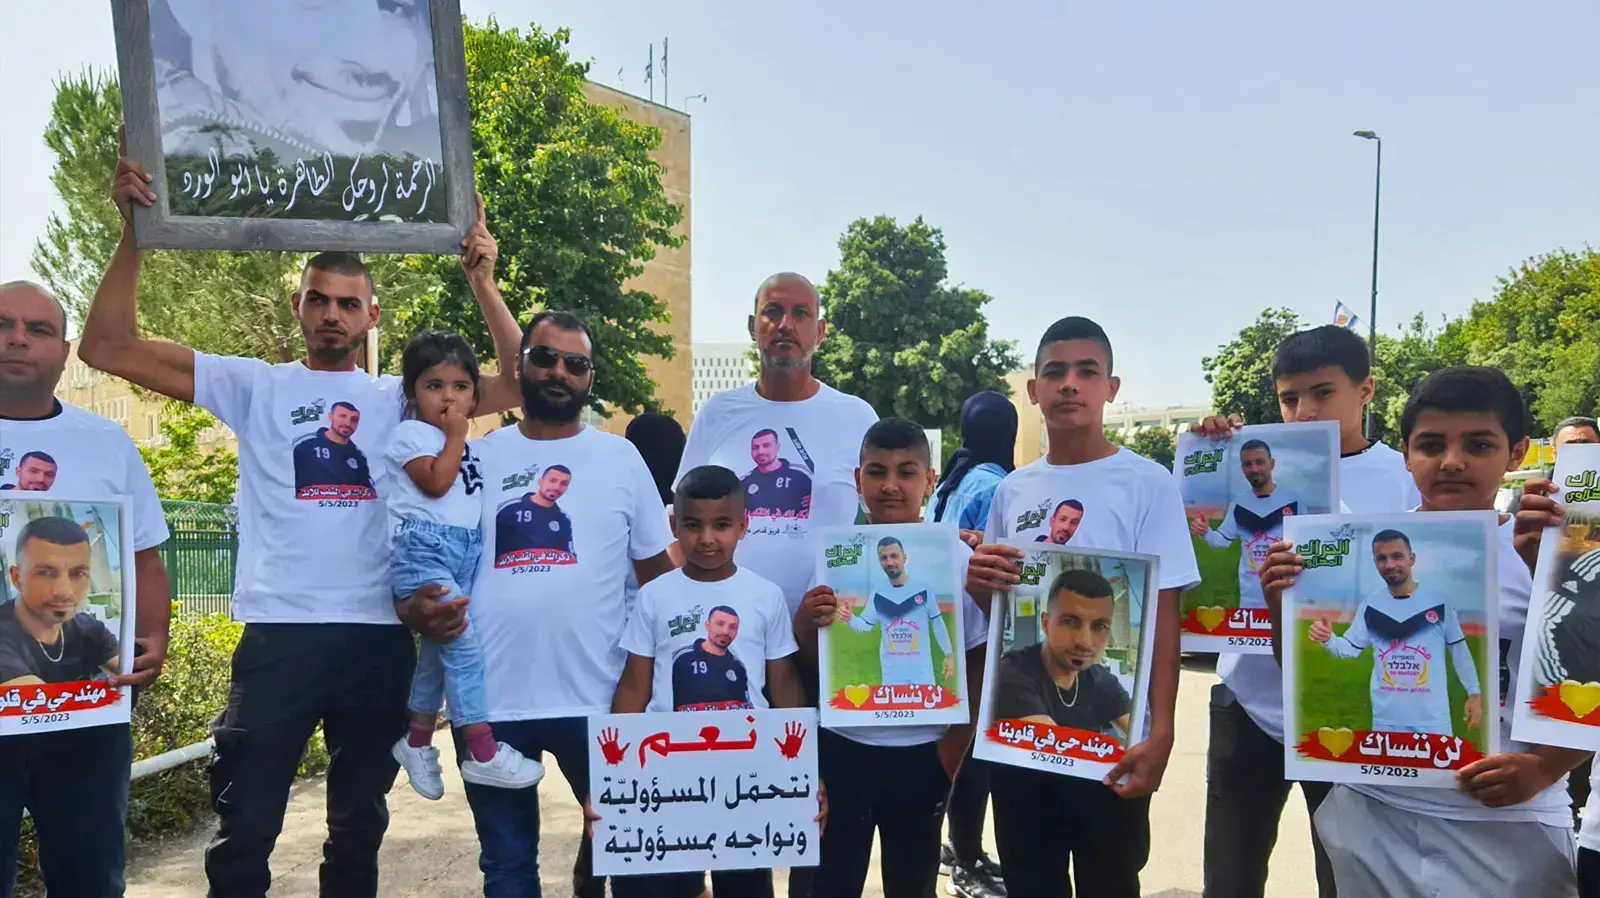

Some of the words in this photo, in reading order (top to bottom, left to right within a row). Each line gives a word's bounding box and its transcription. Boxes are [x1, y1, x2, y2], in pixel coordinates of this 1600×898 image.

[182, 147, 220, 199] الورد
[277, 149, 334, 211] الطاهرة
[254, 163, 273, 206] يا
[395, 156, 436, 214] الرحمة
[314, 446, 330, 459] 19
[1184, 448, 1223, 464] الحراك
[516, 510, 532, 522] 19
[825, 543, 862, 557] الحراك
[1296, 538, 1350, 557] الحراك
[511, 565, 551, 575] 5/5/2023
[1228, 637, 1273, 647] 5/5/2023
[691, 661, 708, 674] 19
[0, 688, 21, 712] قلو
[22, 688, 46, 714] في
[47, 691, 73, 712] حي
[74, 684, 106, 704] مهند
[924, 685, 943, 709] لن
[21, 713, 70, 725] 5/5/2023
[874, 711, 915, 719] 5/5/2023
[638, 715, 757, 769] نعم
[998, 722, 1035, 743] قلوبنا
[1034, 728, 1056, 751] في
[1055, 737, 1080, 754] حي
[1081, 736, 1114, 758] مهند
[1359, 732, 1431, 759] ننساك
[1433, 735, 1463, 768] لن
[1030, 752, 1075, 767] 5/5/2023
[1360, 765, 1418, 778] 5/5/2023
[725, 821, 808, 856] ونواجه
